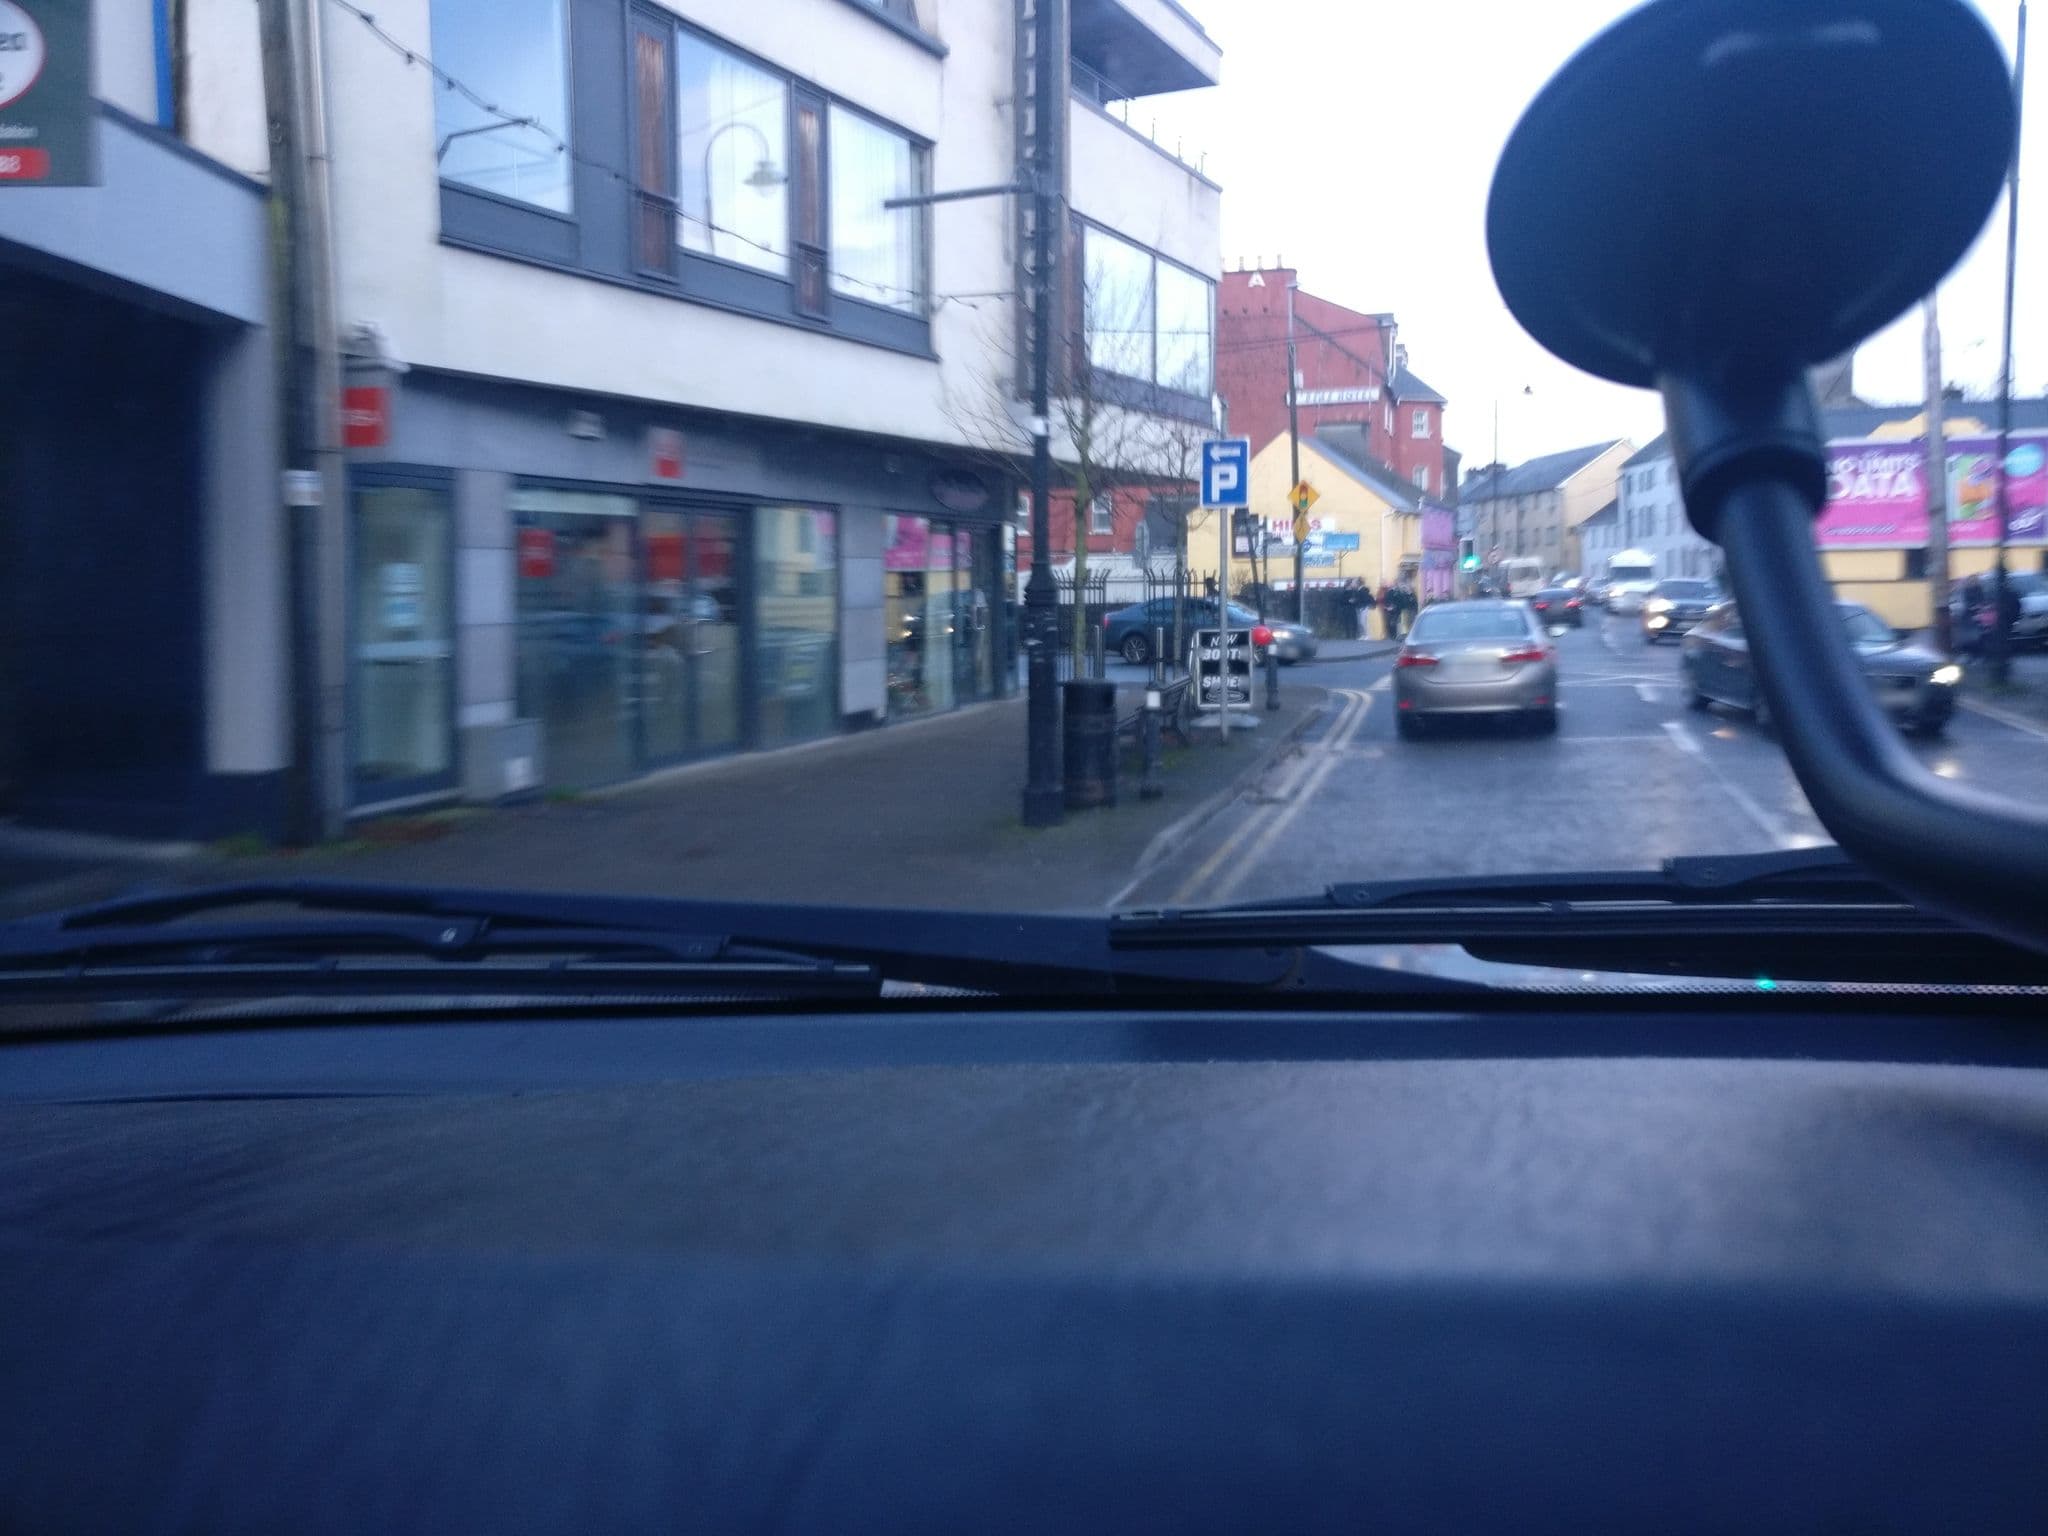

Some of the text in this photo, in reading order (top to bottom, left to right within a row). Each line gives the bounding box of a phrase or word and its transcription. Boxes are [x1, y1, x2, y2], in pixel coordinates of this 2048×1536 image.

[1210, 463, 1238, 503] P
[1272, 519, 1322, 530] HIS
[1210, 633, 1238, 648] NW
[1202, 648, 1241, 661] BOT
[1202, 675, 1241, 689] SHE
